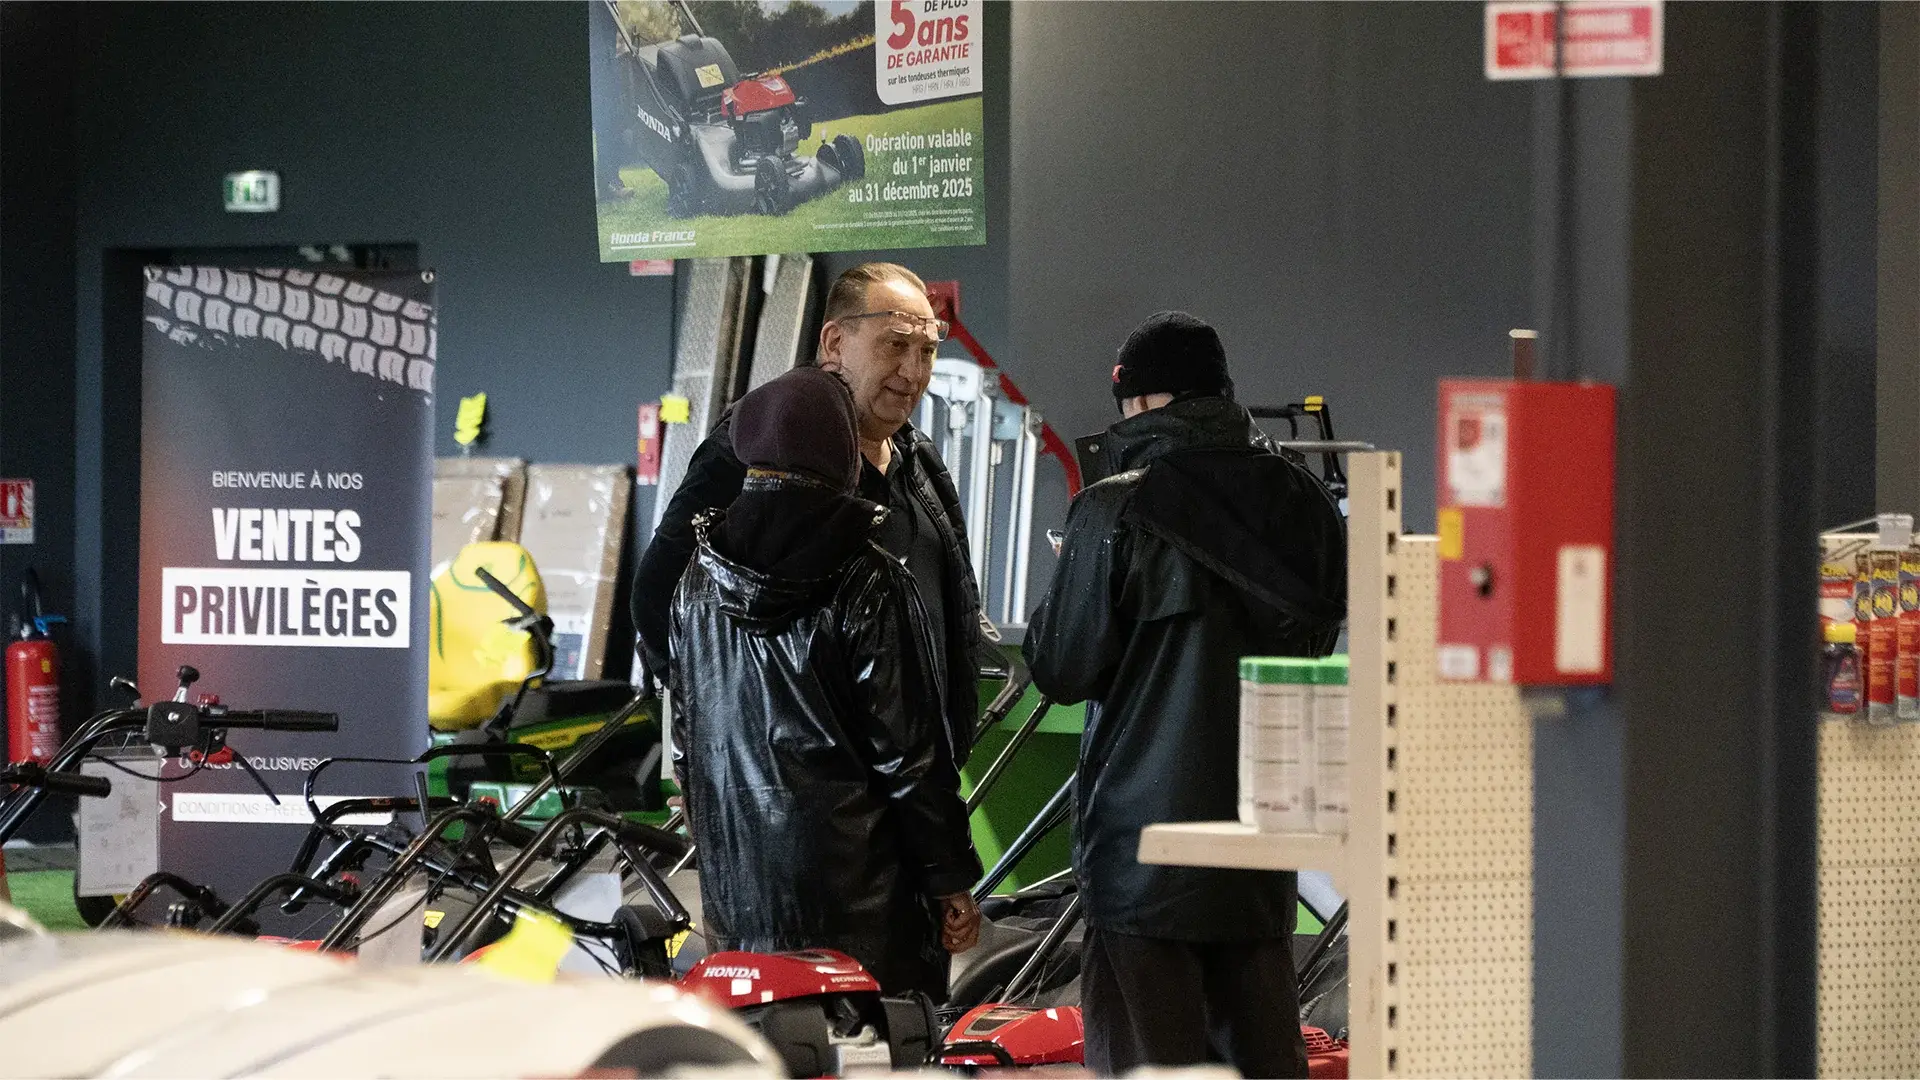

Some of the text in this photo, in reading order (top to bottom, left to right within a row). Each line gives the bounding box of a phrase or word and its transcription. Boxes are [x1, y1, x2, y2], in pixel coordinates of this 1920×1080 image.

[924, 1, 938, 13] DE
[887, 1, 969, 51] 5 ans
[887, 53, 904, 70] DE
[888, 66, 970, 86] sur les tondeuses thermiques
[637, 104, 673, 143] HONDA
[866, 128, 972, 155] Opération valable
[893, 153, 973, 178] du 1er janvier
[849, 177, 973, 203] au 31 décembre 2025
[610, 229, 697, 245] Honda France
[212, 469, 363, 490] BIENVENUE À NOS
[212, 508, 362, 563] VENTES
[174, 578, 398, 638] PRIVILÈGES
[178, 800, 260, 818] CONDITIONS
[703, 966, 761, 980] HONDA
